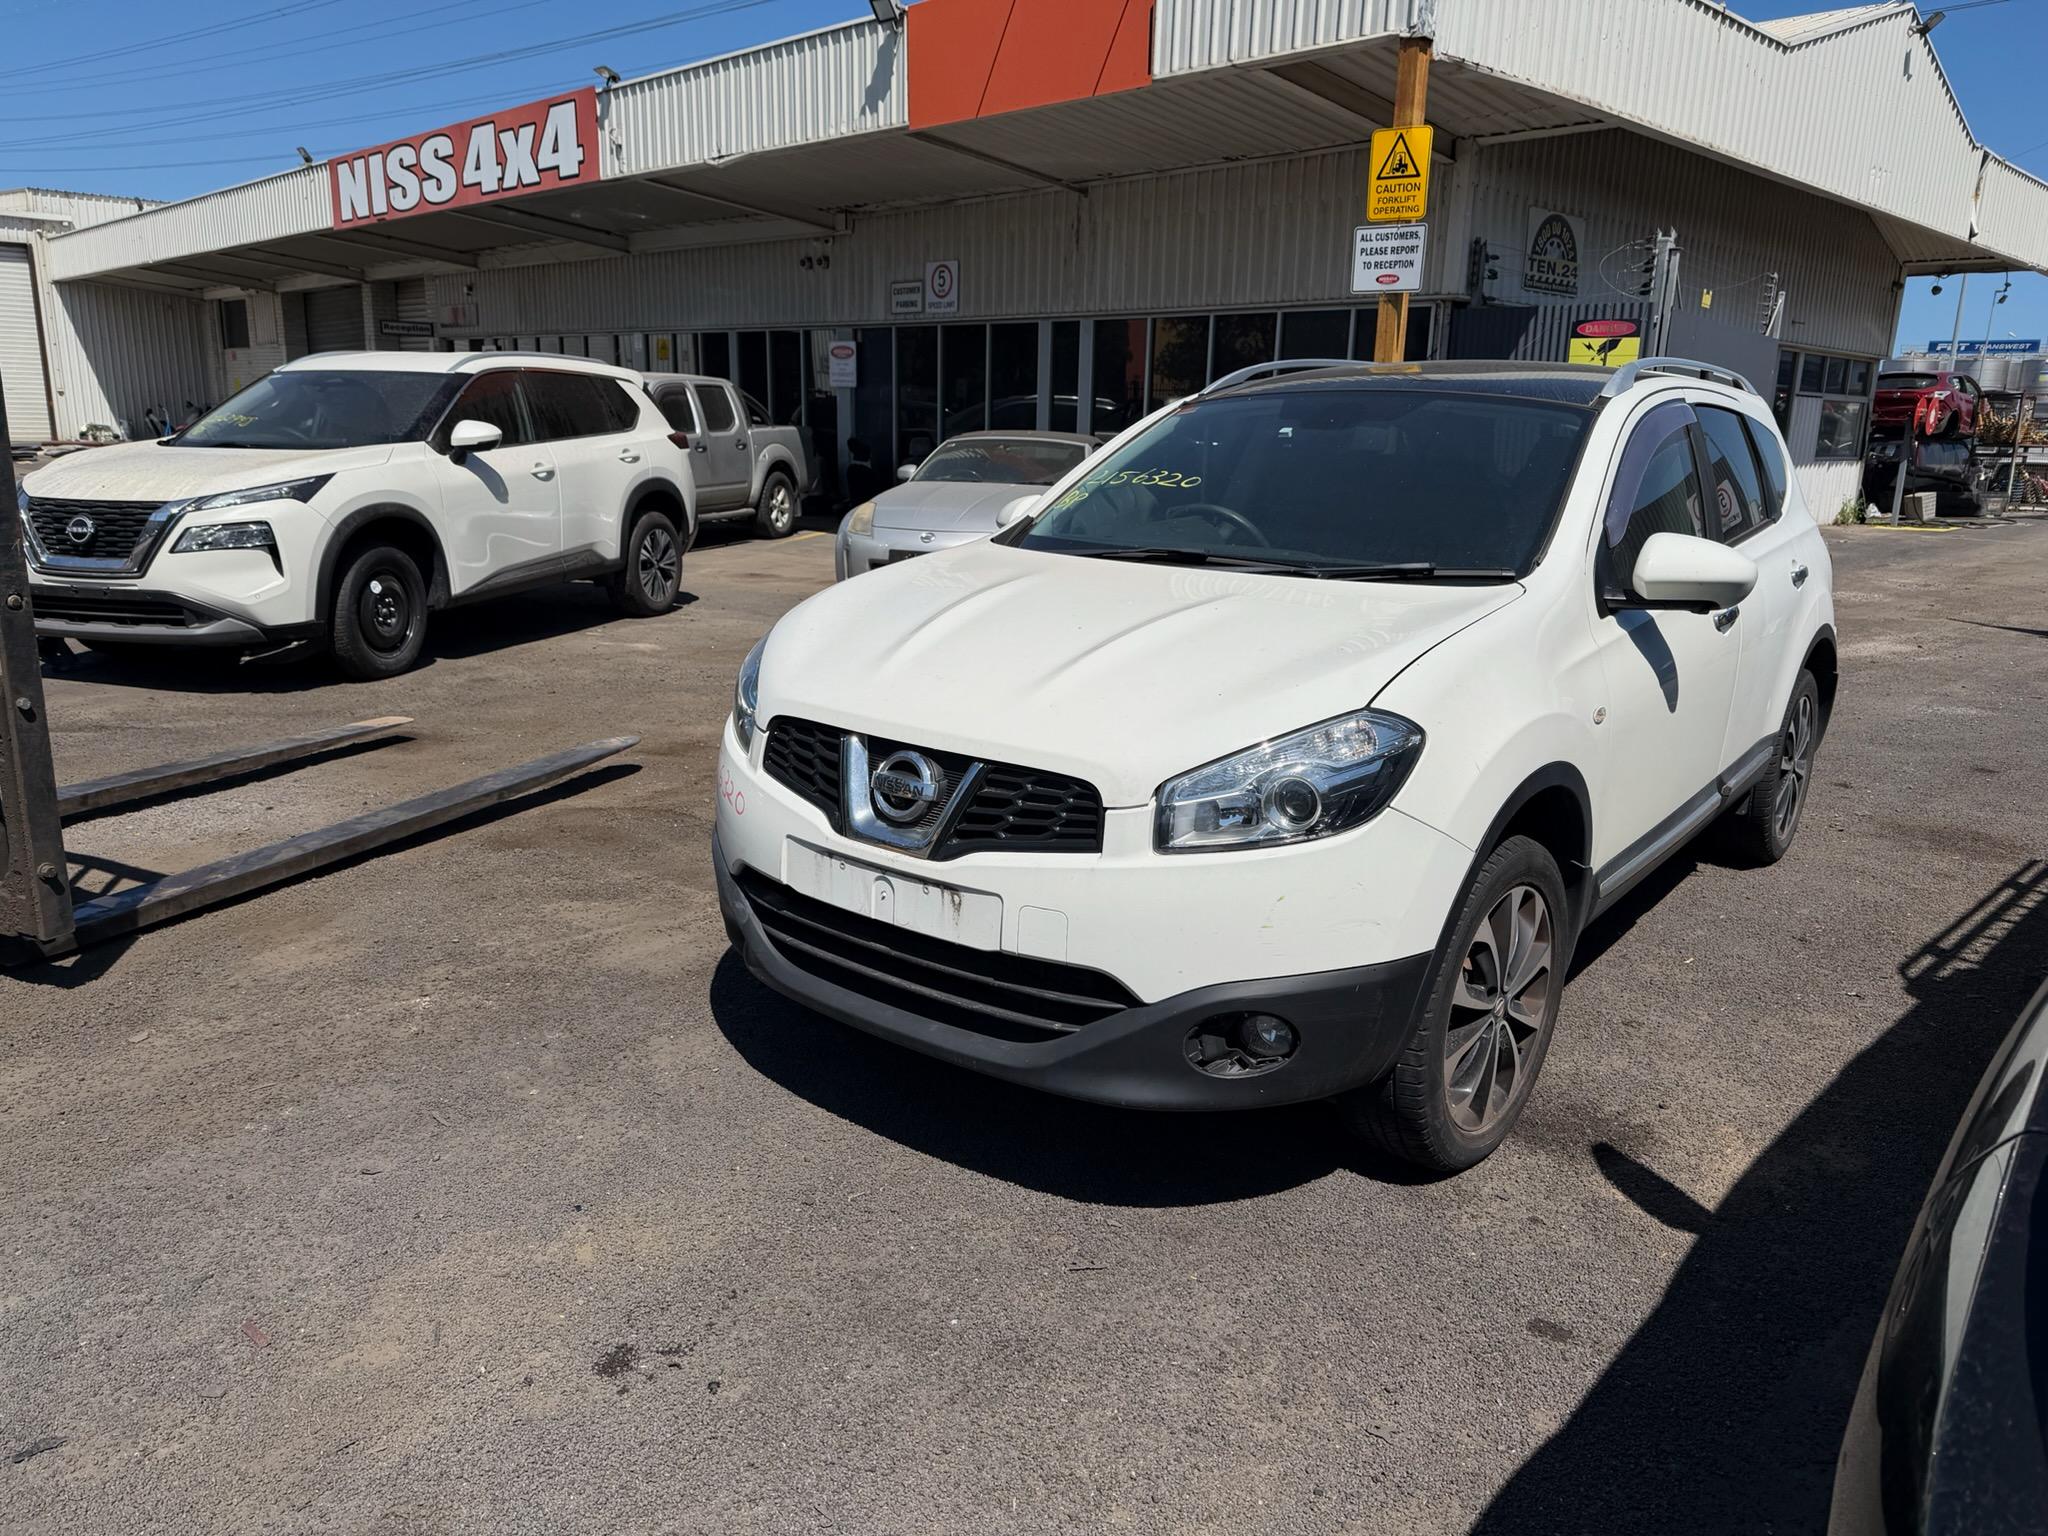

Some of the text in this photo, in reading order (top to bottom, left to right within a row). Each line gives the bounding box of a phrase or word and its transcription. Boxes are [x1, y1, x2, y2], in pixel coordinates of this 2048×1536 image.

[336, 98, 584, 222] NISS 4x4
[1376, 182, 1421, 194] CAUTION
[1377, 195, 1417, 205] FORKLIFT
[1373, 205, 1420, 215] OPERATING
[1360, 230, 1421, 242] ALL CUSTOMERS,
[1360, 245, 1420, 256] PLEASE REPORT
[1363, 259, 1414, 270] TO RECEPTION
[1527, 257, 1578, 280] TEN.24
[938, 269, 946, 288] 5
[1974, 343, 2032, 351] TRANSWEST
[874, 773, 925, 797] NISSAN
